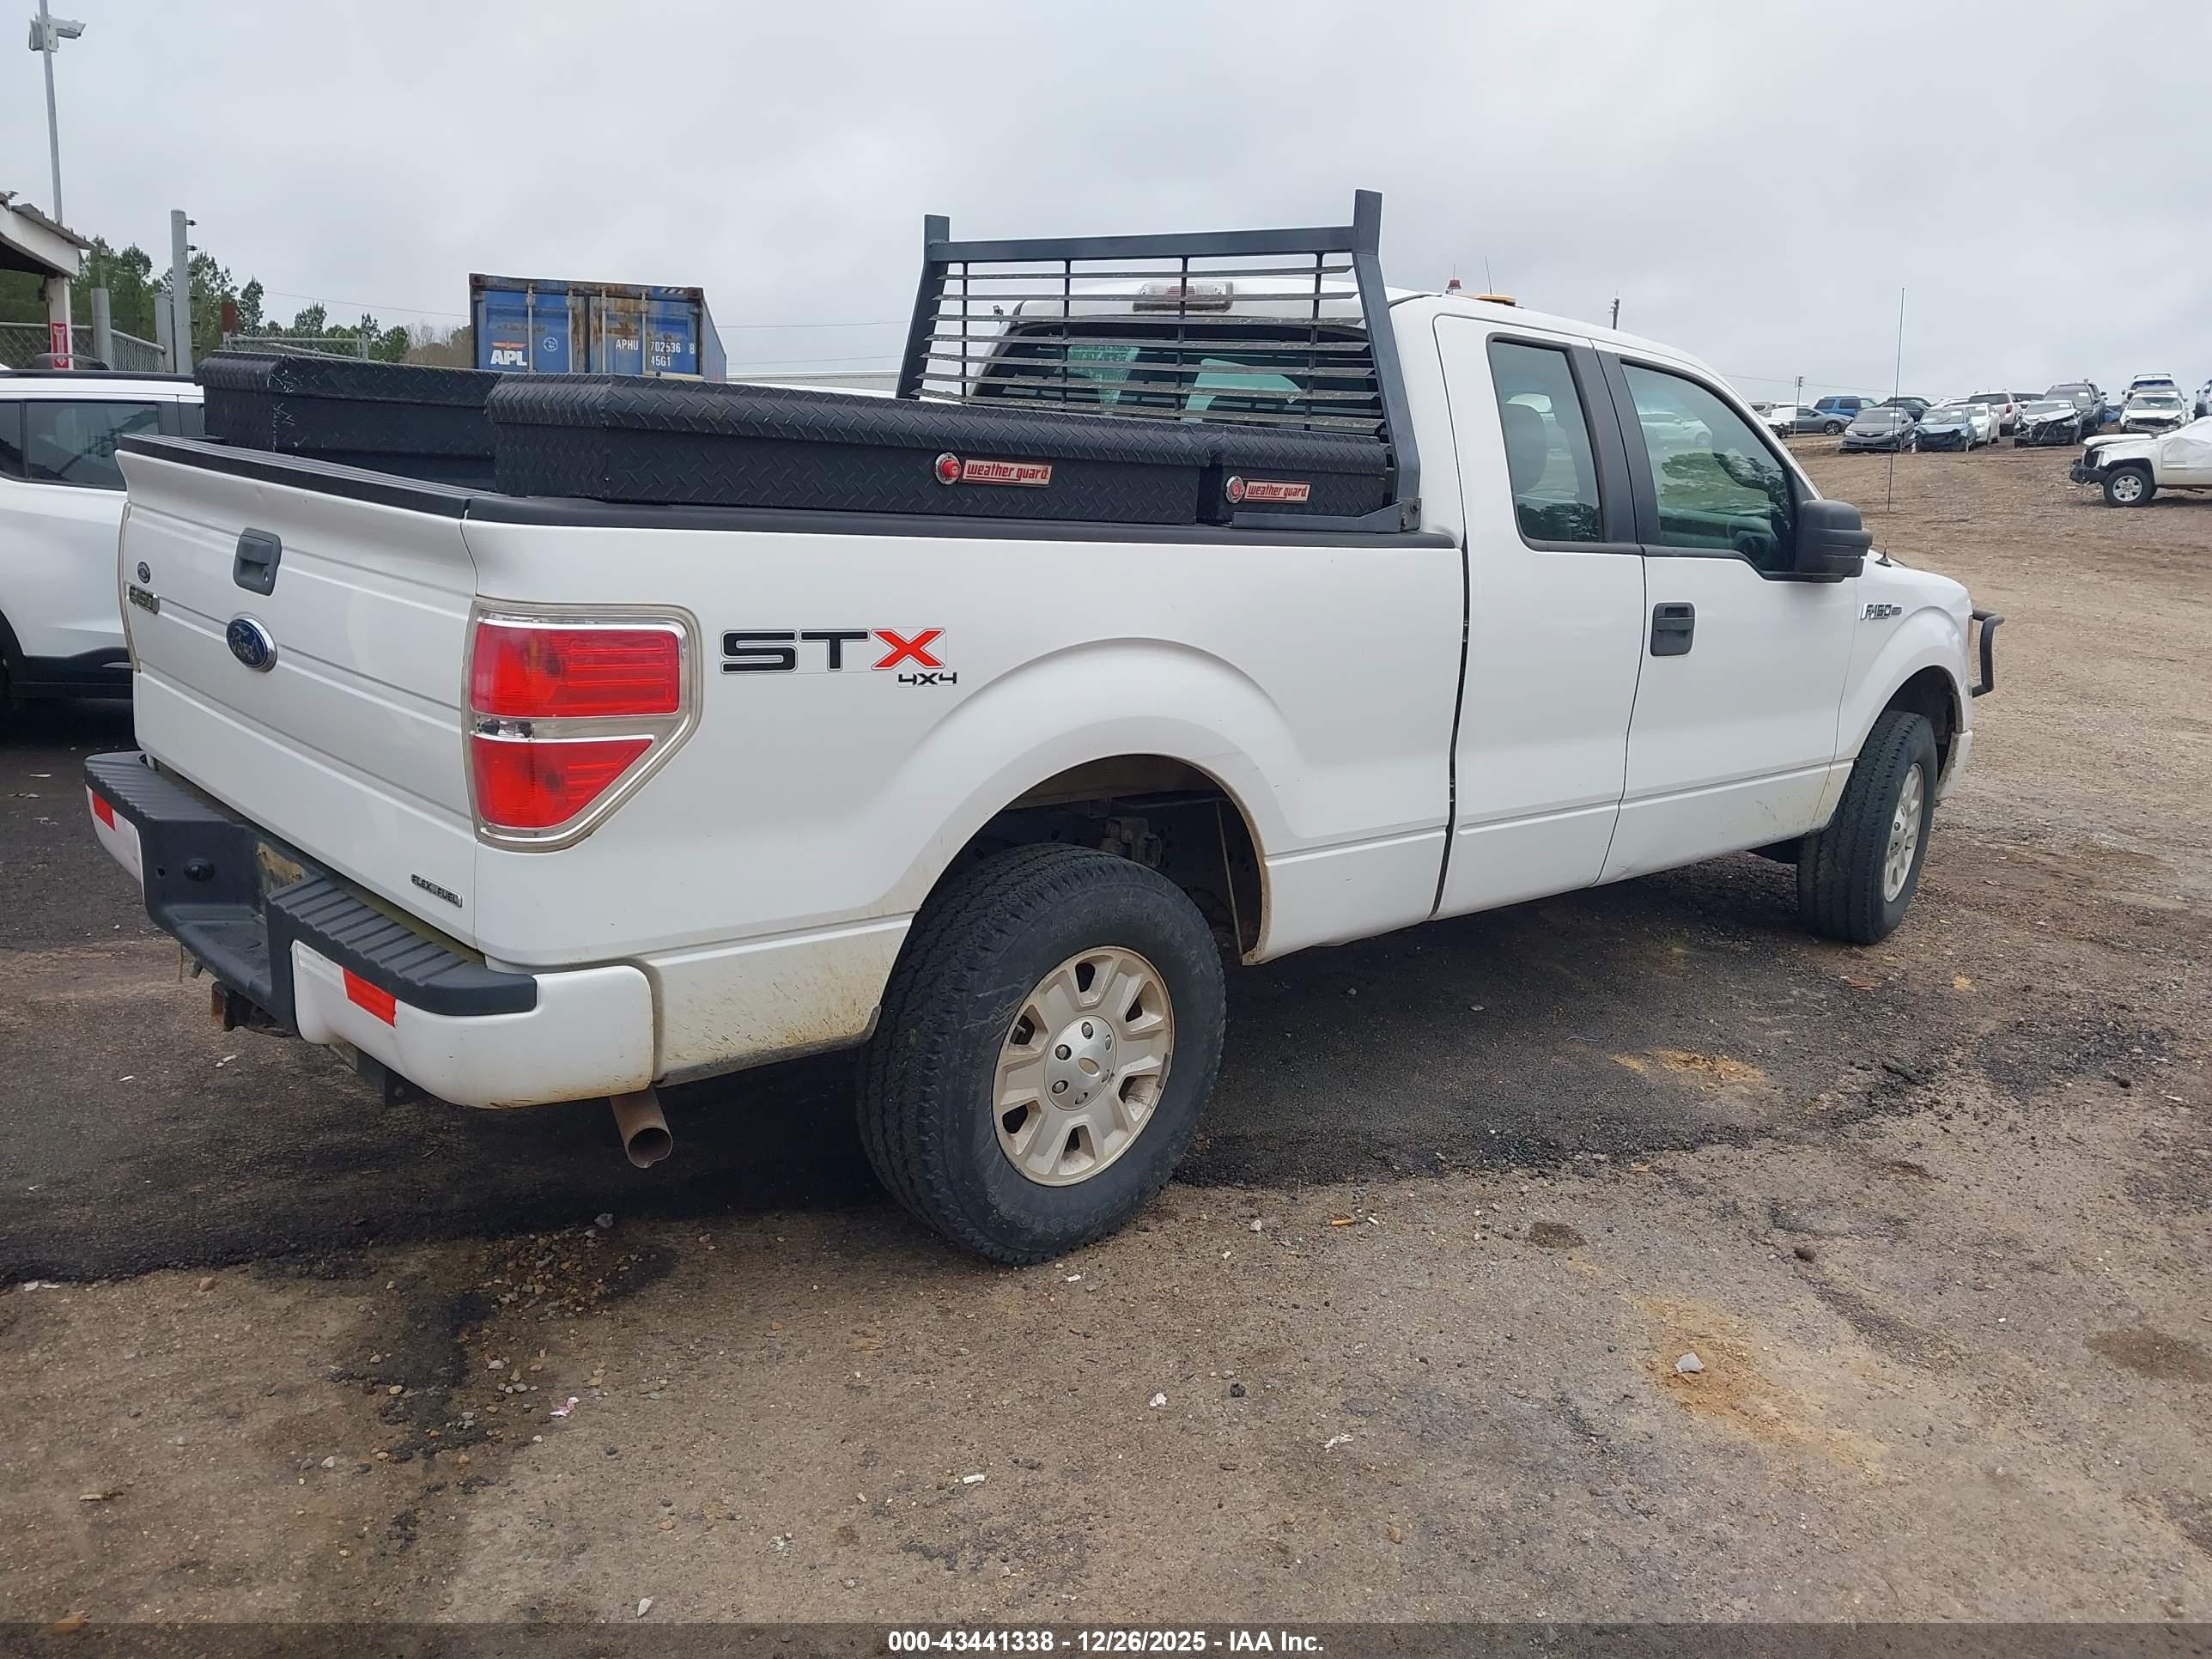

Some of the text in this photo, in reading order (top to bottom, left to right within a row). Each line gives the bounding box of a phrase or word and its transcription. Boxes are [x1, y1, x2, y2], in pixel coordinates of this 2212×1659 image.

[616, 339, 696, 355] APHU 702536 8
[490, 349, 527, 366] APL
[651, 355, 671, 367] 45G1
[967, 463, 1048, 482] weather guard
[1248, 484, 1308, 498] weather guard
[721, 629, 945, 673] STX
[412, 874, 459, 905] FLEX FUEL
